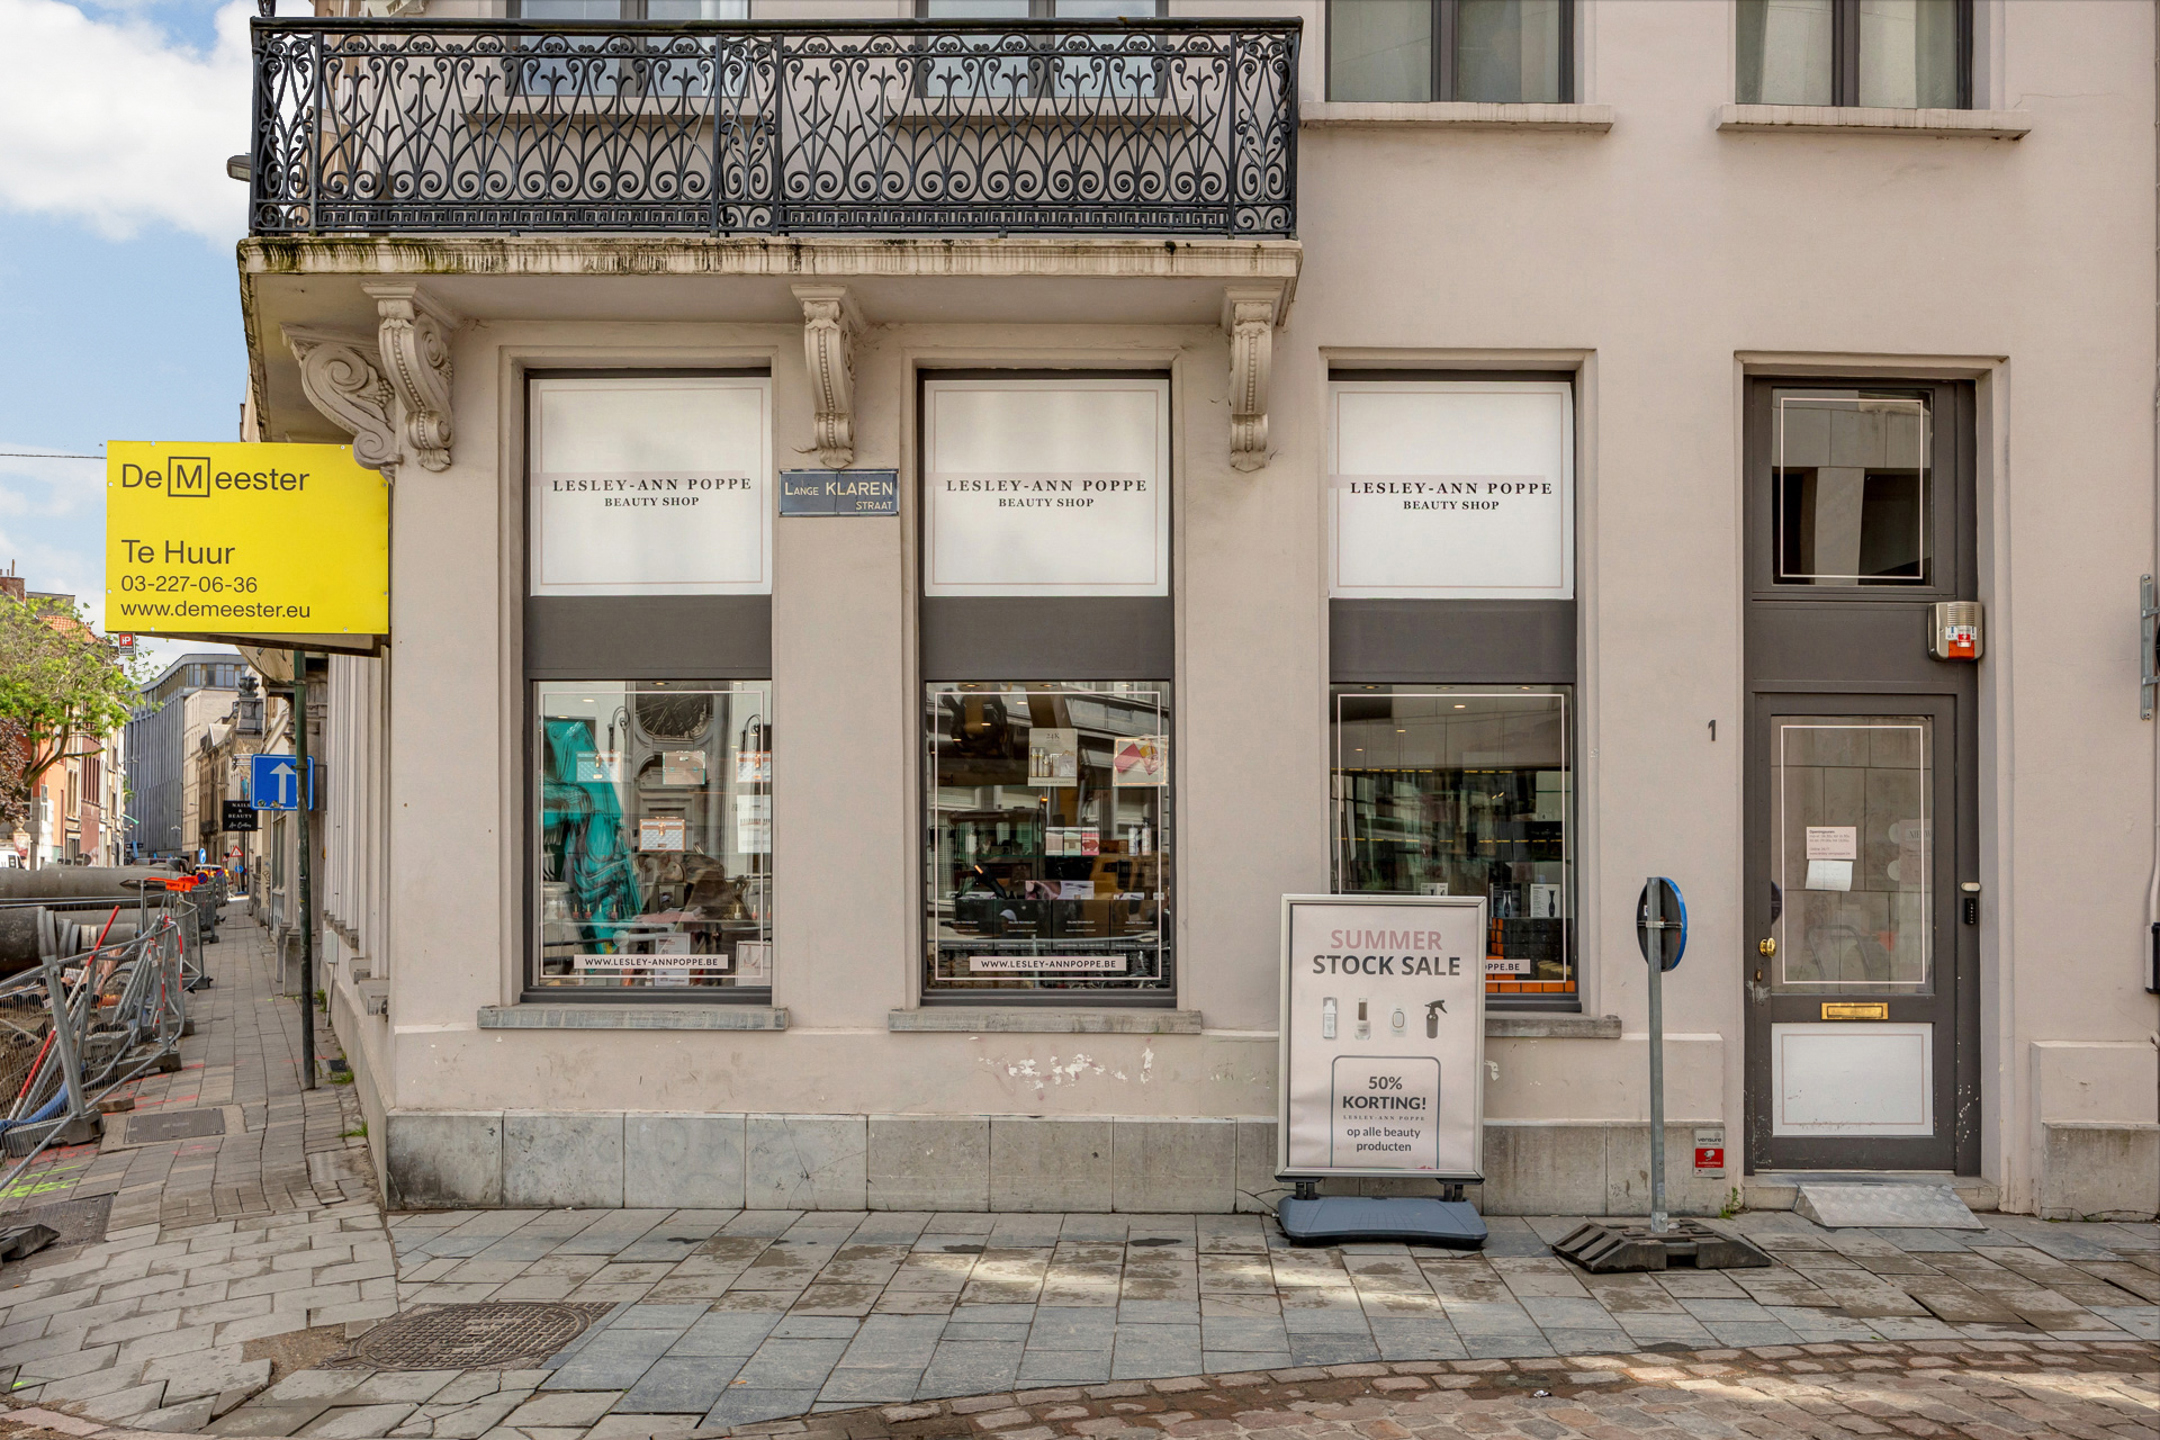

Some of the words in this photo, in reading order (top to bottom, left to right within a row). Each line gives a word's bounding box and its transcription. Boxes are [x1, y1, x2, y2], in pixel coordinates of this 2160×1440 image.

[552, 478, 679, 492] LESLEY-ANN
[687, 477, 752, 491] POPPE
[825, 481, 893, 497] KLAREN
[946, 479, 1074, 492] LESLEY-ANN
[1082, 479, 1148, 492] POPPE
[1350, 482, 1479, 495] LESLEY-ANN
[1487, 482, 1553, 495] POPPE
[604, 497, 658, 508] BEAUTY
[662, 496, 700, 507] SHOP
[855, 500, 893, 512] STRAAT
[998, 497, 1053, 508] BEAUTY
[1056, 498, 1095, 508] SHOP
[1403, 500, 1458, 511] BEAUTY
[1461, 501, 1500, 511] SHOP
[121, 539, 155, 564] Te
[165, 539, 236, 565] Huur
[121, 575, 258, 594] 03-227-06-36
[120, 600, 311, 619] www.demeester.eu
[1706, 719, 1717, 742] 1
[1330, 929, 1443, 951] SUMMER
[584, 956, 719, 967] WWW.LESLEY-ANNPOPPE.BE
[980, 959, 1117, 969] WWW.LESLEY-ANNPOPPE.BE
[1312, 954, 1395, 976] STOCK
[1400, 955, 1462, 977] SALE
[1367, 1075, 1403, 1091] 50%
[1341, 1094, 1427, 1111] KORTING!
[1346, 1128, 1361, 1139] op
[1362, 1125, 1382, 1138] alle
[1383, 1126, 1421, 1139] beauty
[1355, 1140, 1412, 1153] producten
